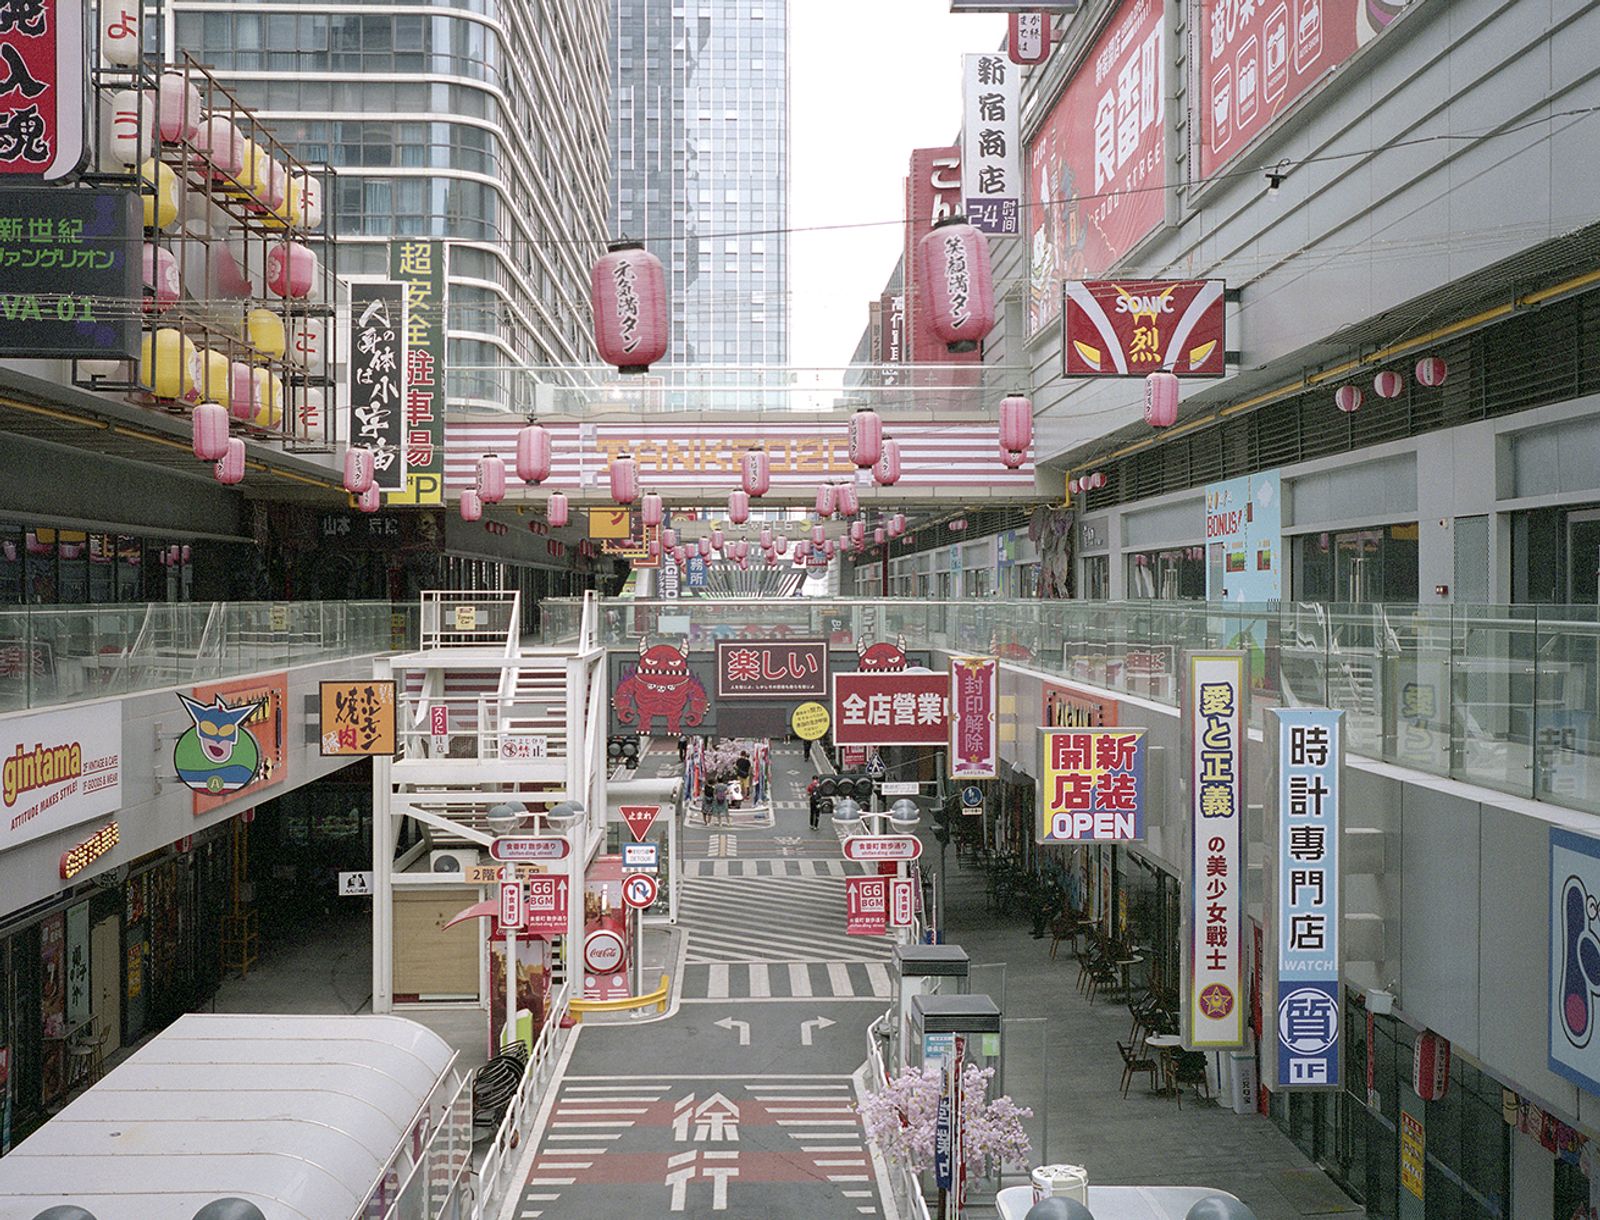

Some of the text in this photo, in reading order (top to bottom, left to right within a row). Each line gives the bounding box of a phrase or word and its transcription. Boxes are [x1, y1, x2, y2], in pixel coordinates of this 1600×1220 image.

[977, 56, 1006, 195] 新宿商店
[0, 217, 84, 244] 新世紀
[1115, 295, 1175, 314] SONIC
[1129, 325, 1161, 363] 烈
[415, 475, 438, 503] P
[1207, 509, 1243, 538] BONUS!
[727, 648, 819, 681] 楽しい
[360, 685, 382, 751] ホルモン
[1200, 681, 1235, 819] 愛と正義
[3, 742, 82, 808] gintama
[10, 804, 39, 832] ATTITUDE
[39, 791, 59, 814] MAKES
[628, 811, 652, 820] 止まれ
[1051, 811, 1136, 840] OPEN
[530, 896, 553, 906] BGM
[532, 882, 551, 894] G6
[861, 897, 883, 907] BGM
[862, 884, 881, 897] G6
[1283, 959, 1333, 971] WATCH
[1287, 998, 1330, 1044] 質
[1293, 1063, 1327, 1080] 1F
[664, 1091, 740, 1212] 徐行
